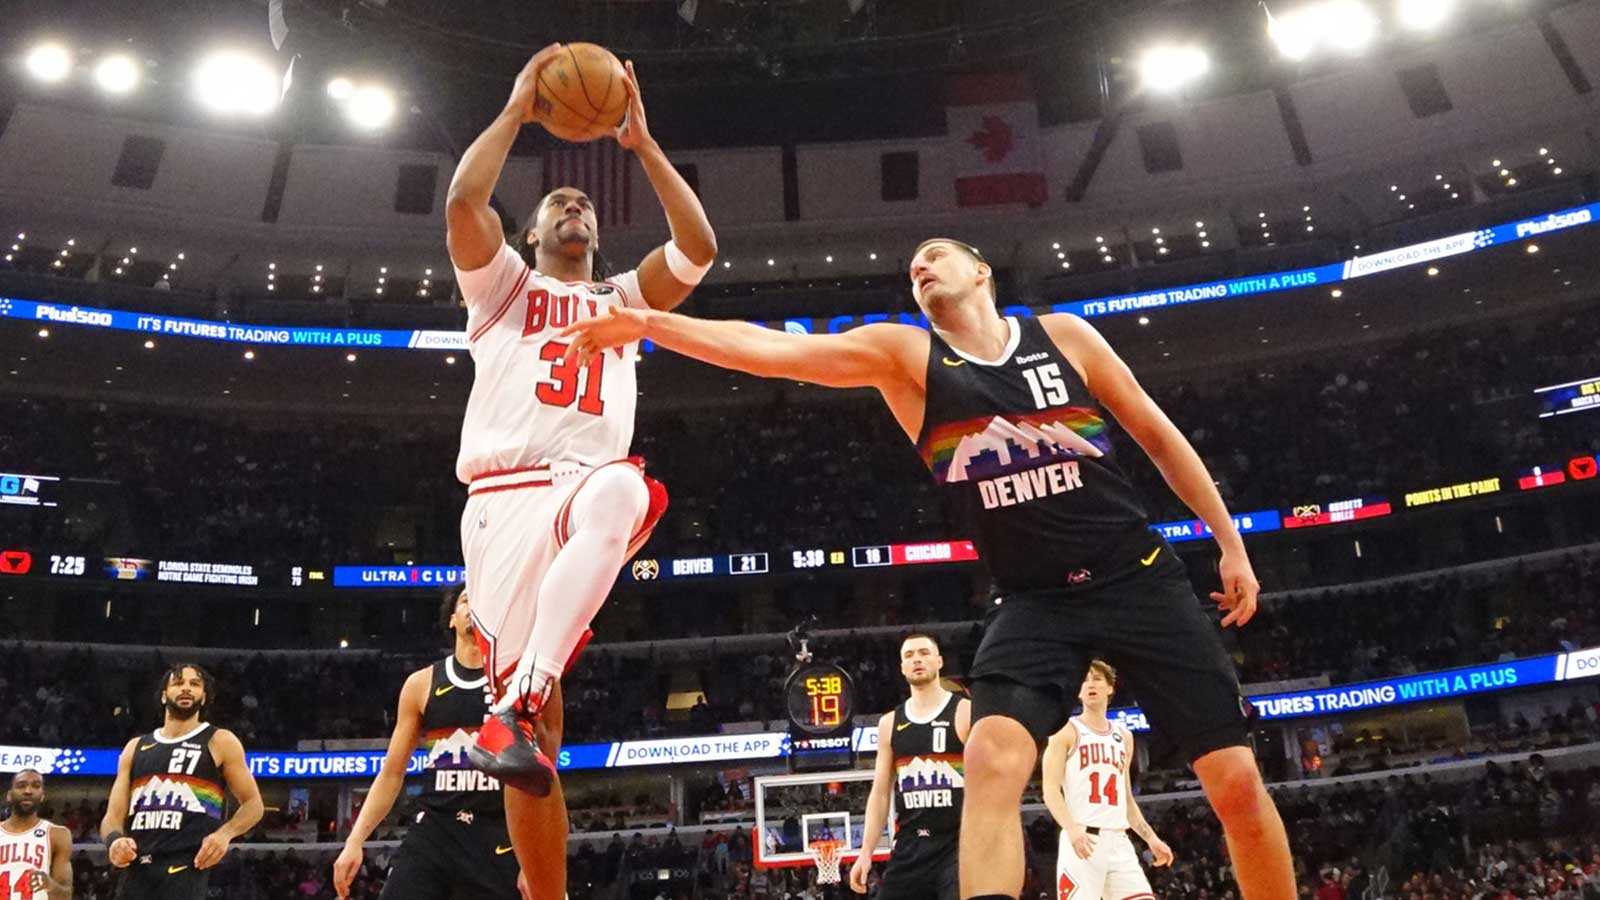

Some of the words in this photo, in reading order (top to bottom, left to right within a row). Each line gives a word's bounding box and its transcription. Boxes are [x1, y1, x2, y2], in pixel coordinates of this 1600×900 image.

[1516, 209, 1592, 237] Plus500
[1357, 250, 1420, 271] DOWNLOAD
[1422, 246, 1442, 257] THE
[1445, 239, 1466, 252] APP
[1084, 301, 1106, 315] IT'S
[1108, 293, 1167, 312] FUTURES
[1169, 284, 1227, 303] TRADING
[1228, 280, 1267, 295] WITH
[1268, 278, 1280, 289] A
[1281, 271, 1317, 287] PLUS
[35, 304, 113, 327] Plus500
[138, 317, 162, 331] IT'S
[163, 319, 227, 338] FUTURES
[228, 326, 290, 344] TRADING
[293, 331, 331, 344] WITH
[333, 332, 345, 344] A
[346, 332, 382, 345] PLUS
[424, 335, 468, 345] DOWNL
[535, 340, 605, 416] 31
[1022, 363, 1069, 409] 15
[977, 460, 1083, 510] DENVER
[1405, 489, 1442, 507] POINTS
[1441, 486, 1453, 501] IN
[1452, 483, 1472, 498] THE
[1472, 477, 1500, 495] PAINT
[905, 543, 952, 561] CHICAGO
[50, 555, 85, 575] 7:25
[158, 561, 189, 572] FLORIDA
[190, 562, 212, 573] STATE
[212, 564, 252, 575] SEMINOLES
[362, 570, 407, 582] ULTRA
[673, 558, 713, 575] DENVER
[741, 556, 757, 571] 21
[158, 571, 182, 581] NOTRE
[182, 572, 204, 583] DAME
[204, 574, 237, 585] FIGHTING
[806, 677, 842, 696] 5:38
[1252, 695, 1315, 716] TURES
[1315, 684, 1396, 711] TRADING
[1398, 679, 1450, 699] WITH
[1453, 678, 1467, 692] A
[1470, 667, 1518, 689] PLUS
[812, 695, 840, 726] 19
[627, 743, 711, 760] DOWNLOAD
[716, 742, 739, 754] THE
[743, 740, 771, 752] APP
[808, 738, 850, 749] TISSOT
[932, 727, 946, 753] 0
[12, 754, 43, 767] APP
[167, 748, 202, 775] 27
[250, 756, 280, 773] IT'S
[284, 756, 367, 773] FUTURES
[1079, 743, 1126, 776] BULLS
[435, 770, 500, 791] DENVER
[1088, 771, 1119, 806] 14
[903, 789, 952, 809] DENVER
[0, 843, 45, 869] ULLS
